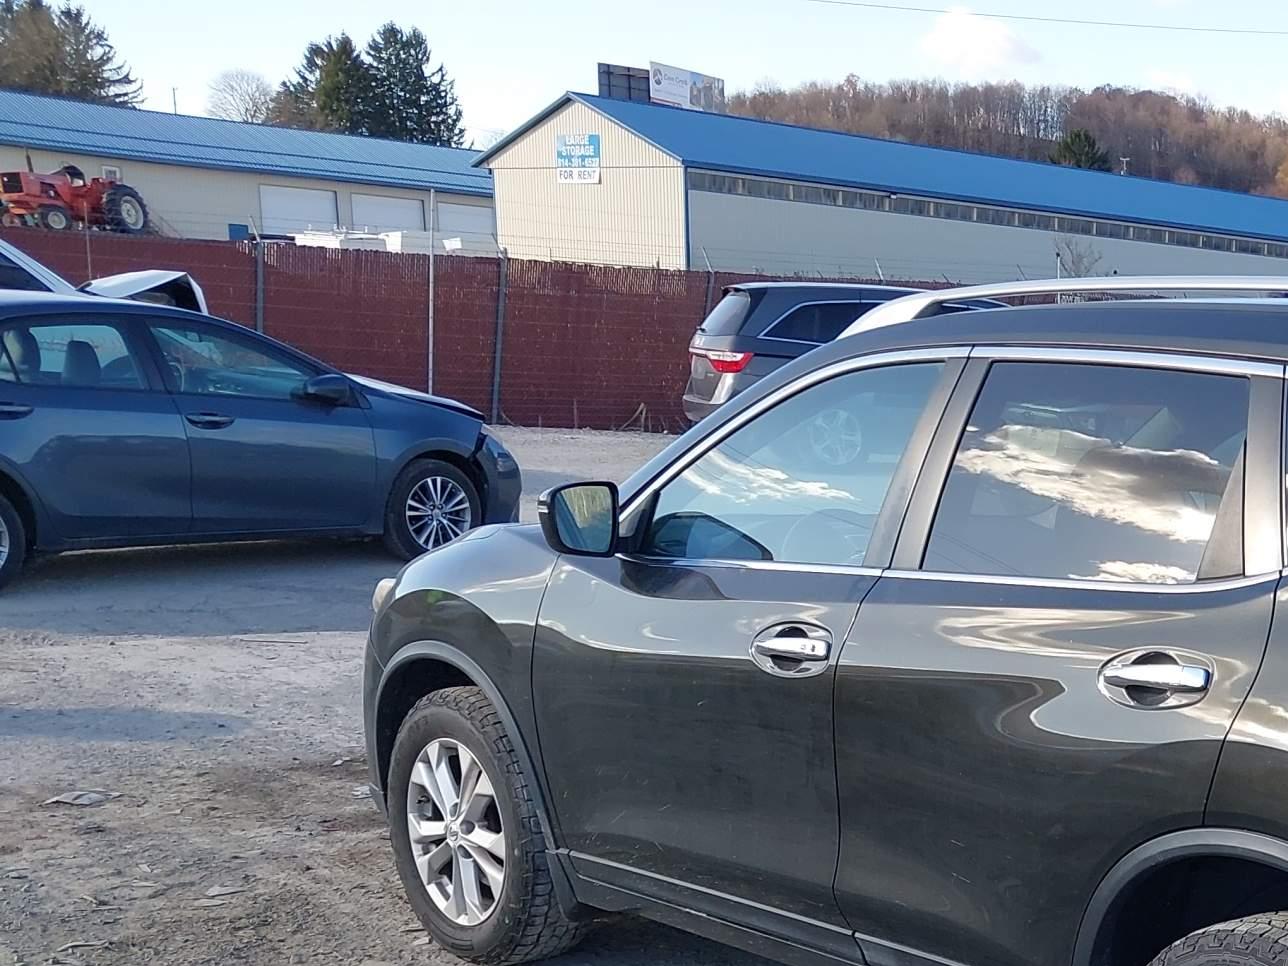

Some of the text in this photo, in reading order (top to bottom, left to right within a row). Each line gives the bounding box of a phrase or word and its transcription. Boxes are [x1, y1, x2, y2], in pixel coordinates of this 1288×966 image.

[566, 135, 589, 145] LARGE
[561, 145, 594, 156] STORAGE
[559, 170, 596, 180] FOR RENT
